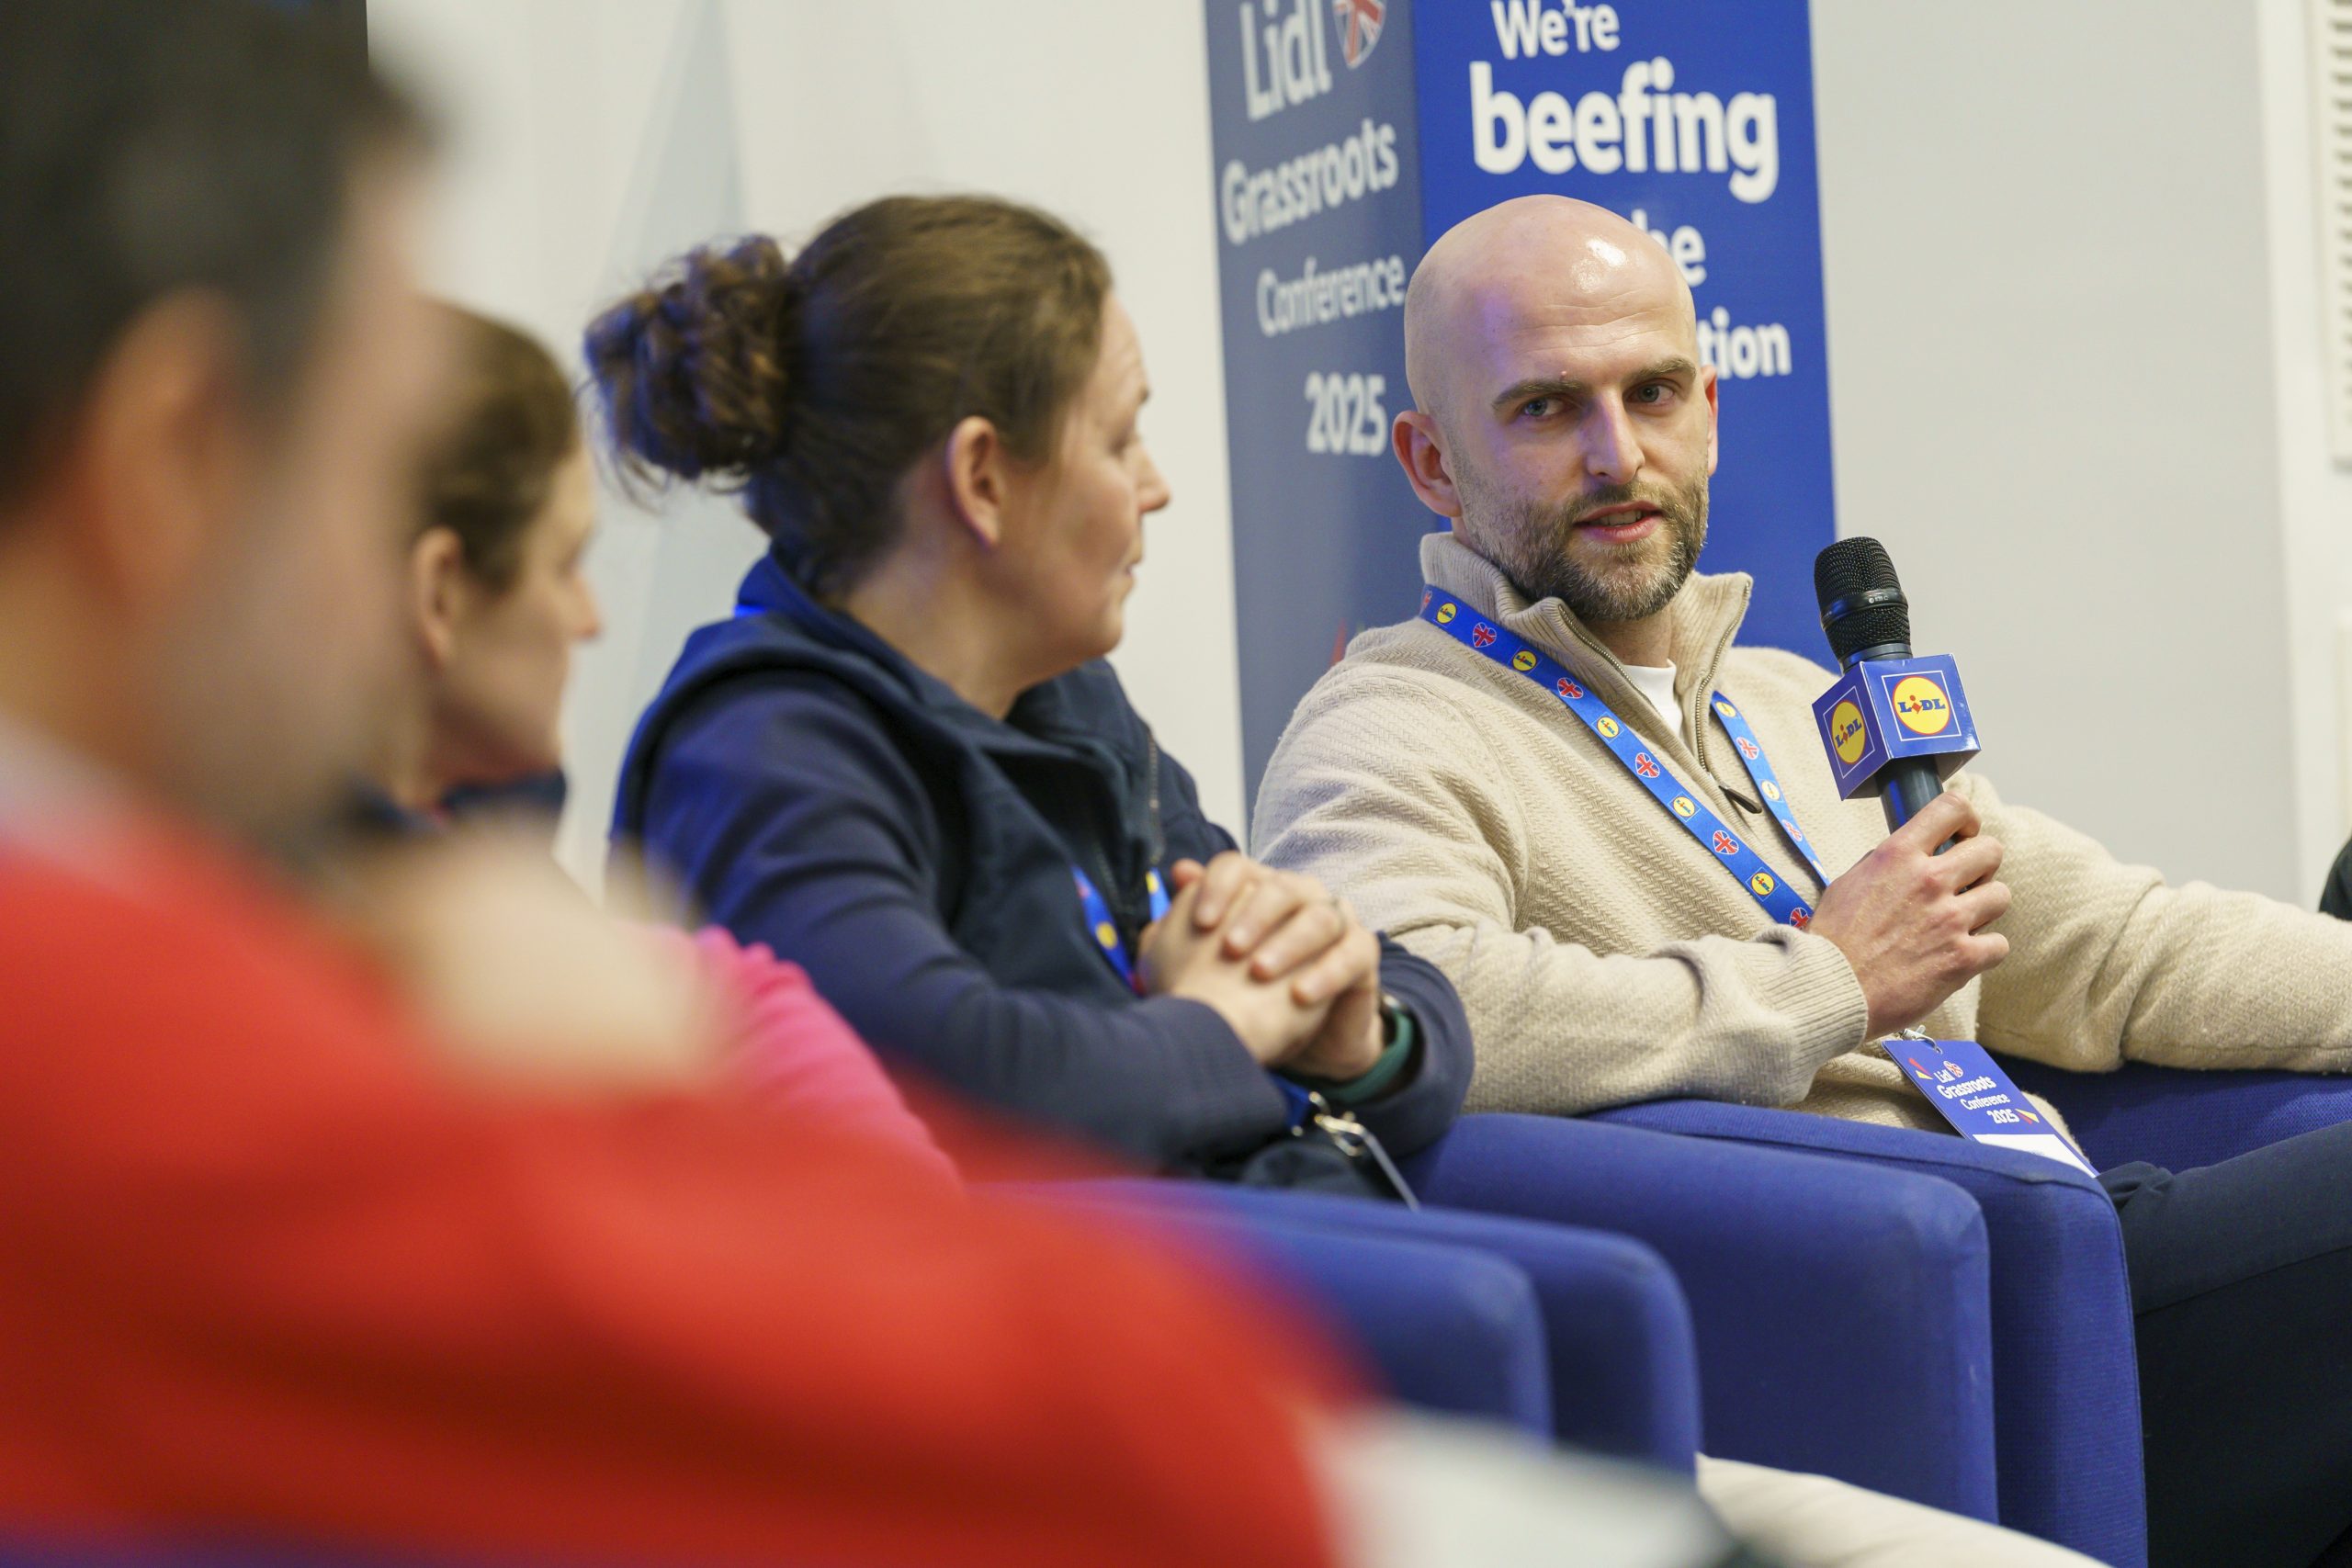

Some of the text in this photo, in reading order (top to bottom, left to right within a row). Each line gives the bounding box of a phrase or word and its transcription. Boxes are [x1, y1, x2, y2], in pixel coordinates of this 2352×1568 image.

[1240, 0, 1332, 121] Lidl
[1490, 0, 1621, 60] We're
[1470, 56, 1780, 204] beefing
[1222, 118, 1399, 245] Grassroots
[1257, 254, 1407, 337] Conference
[1696, 305, 1792, 380] tion
[1305, 370, 1388, 457] 2025
[1937, 1076, 1996, 1099] Grassroots
[1960, 1094, 2010, 1110] Conference
[1986, 1109, 2019, 1123] 2025
